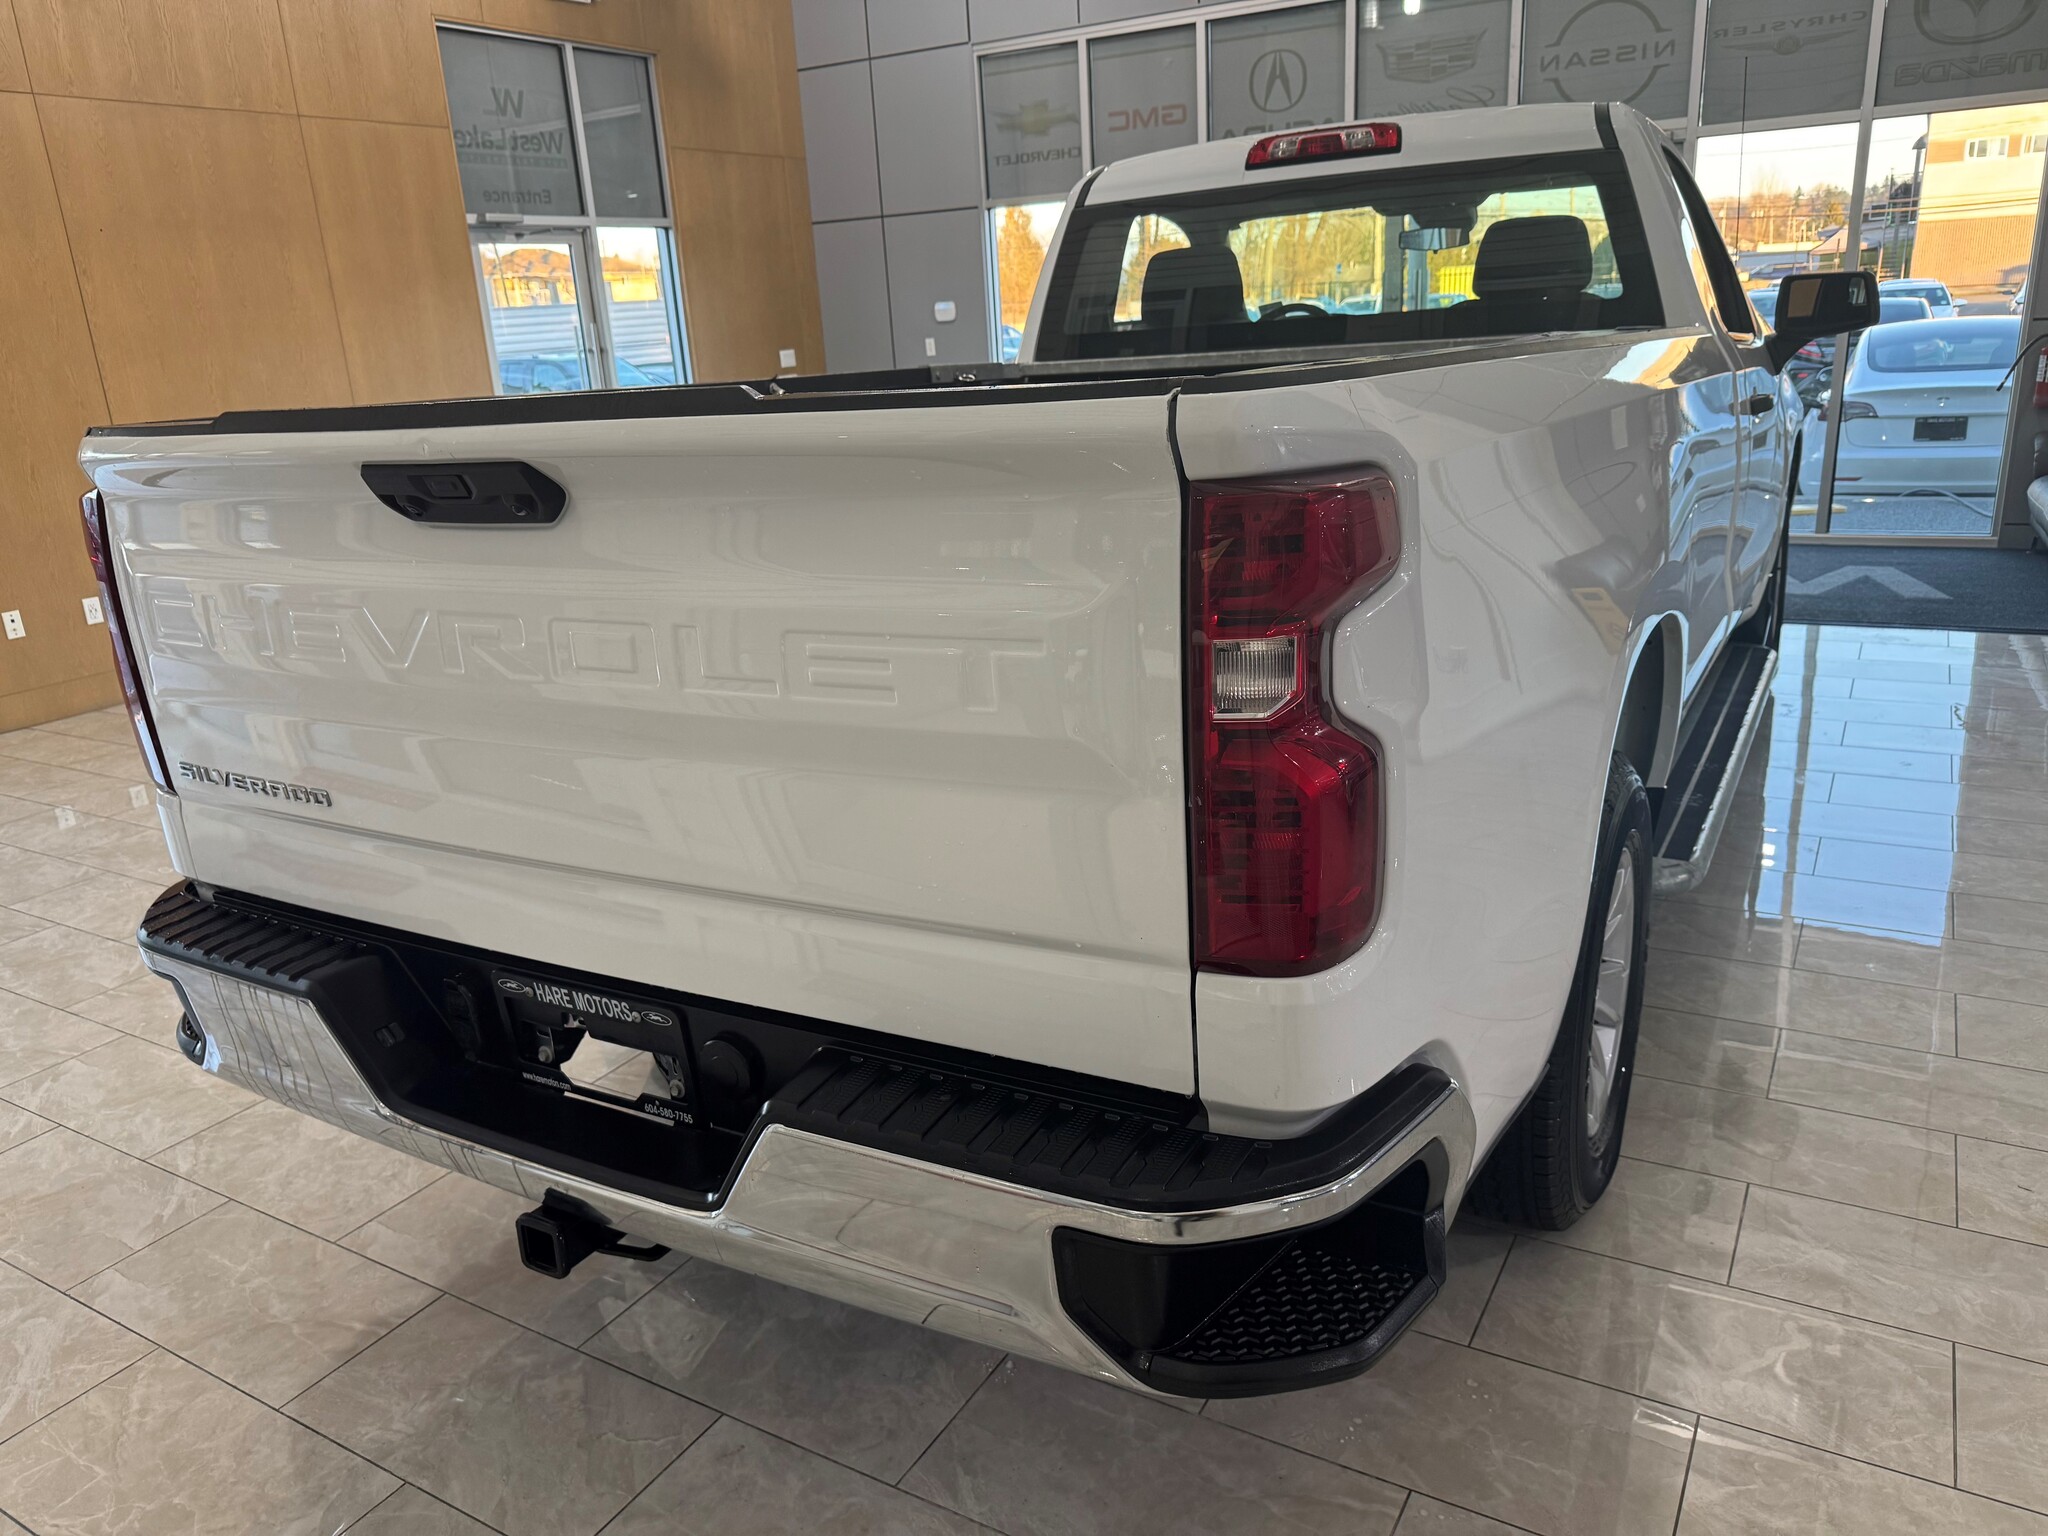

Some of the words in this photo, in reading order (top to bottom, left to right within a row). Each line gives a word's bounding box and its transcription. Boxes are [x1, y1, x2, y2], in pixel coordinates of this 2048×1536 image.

[146, 585, 1045, 713] CHEVROLET
[178, 760, 334, 808] SILVERADO
[533, 982, 573, 1009] HARE
[573, 993, 634, 1023] MOTORS
[644, 1102, 694, 1124] 604-580-7755
